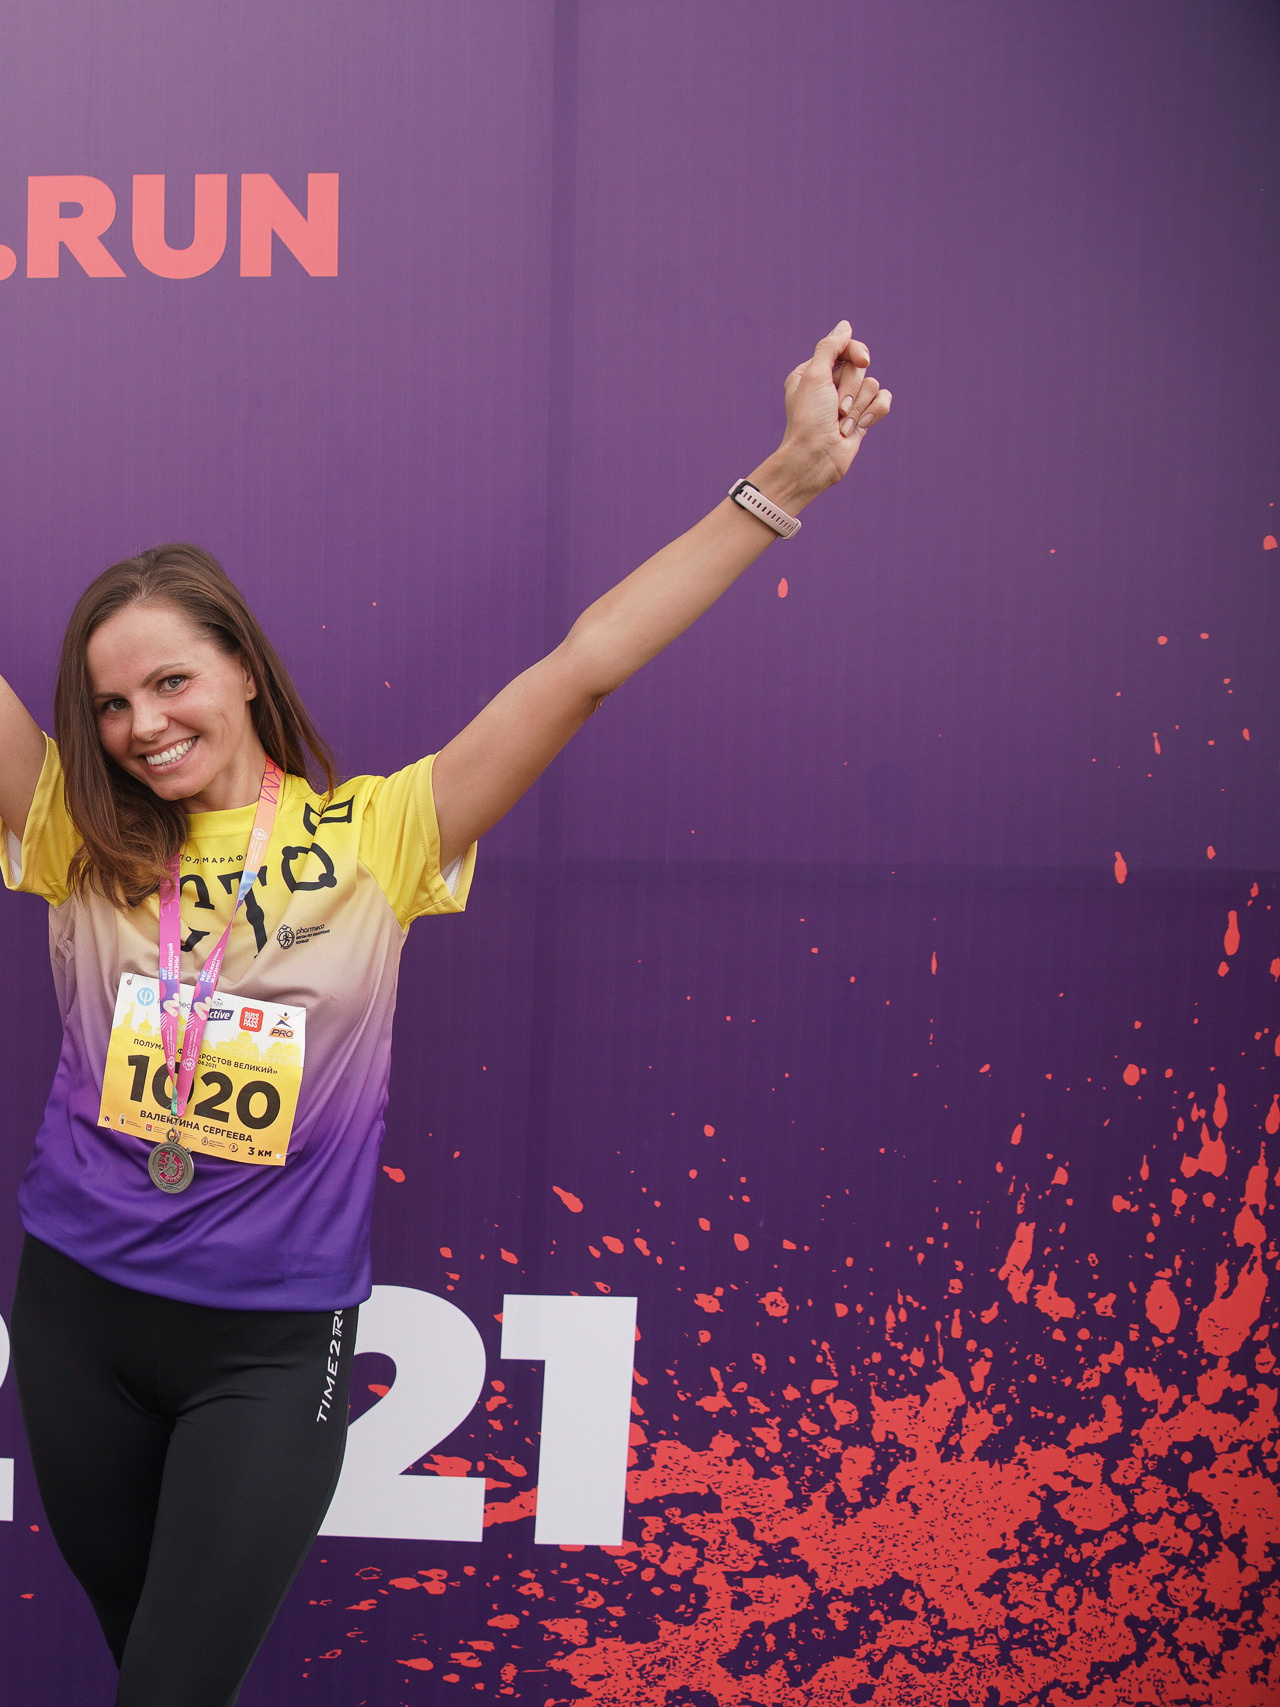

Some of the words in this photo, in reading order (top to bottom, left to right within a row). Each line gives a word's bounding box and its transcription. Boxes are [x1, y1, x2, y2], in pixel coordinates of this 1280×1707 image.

[209, 1009, 231, 1020] ctive
[244, 1011, 260, 1021] RUSS
[243, 1019, 259, 1029] PASS
[270, 1029, 294, 1038] PRO
[233, 1061, 278, 1075] ВЕЛИКИЙ»
[127, 1054, 281, 1130] 1020
[139, 1109, 200, 1132] ВАЛЕНТИНА
[202, 1124, 253, 1143] СЕРГЕЕВА
[247, 1146, 255, 1156] 3
